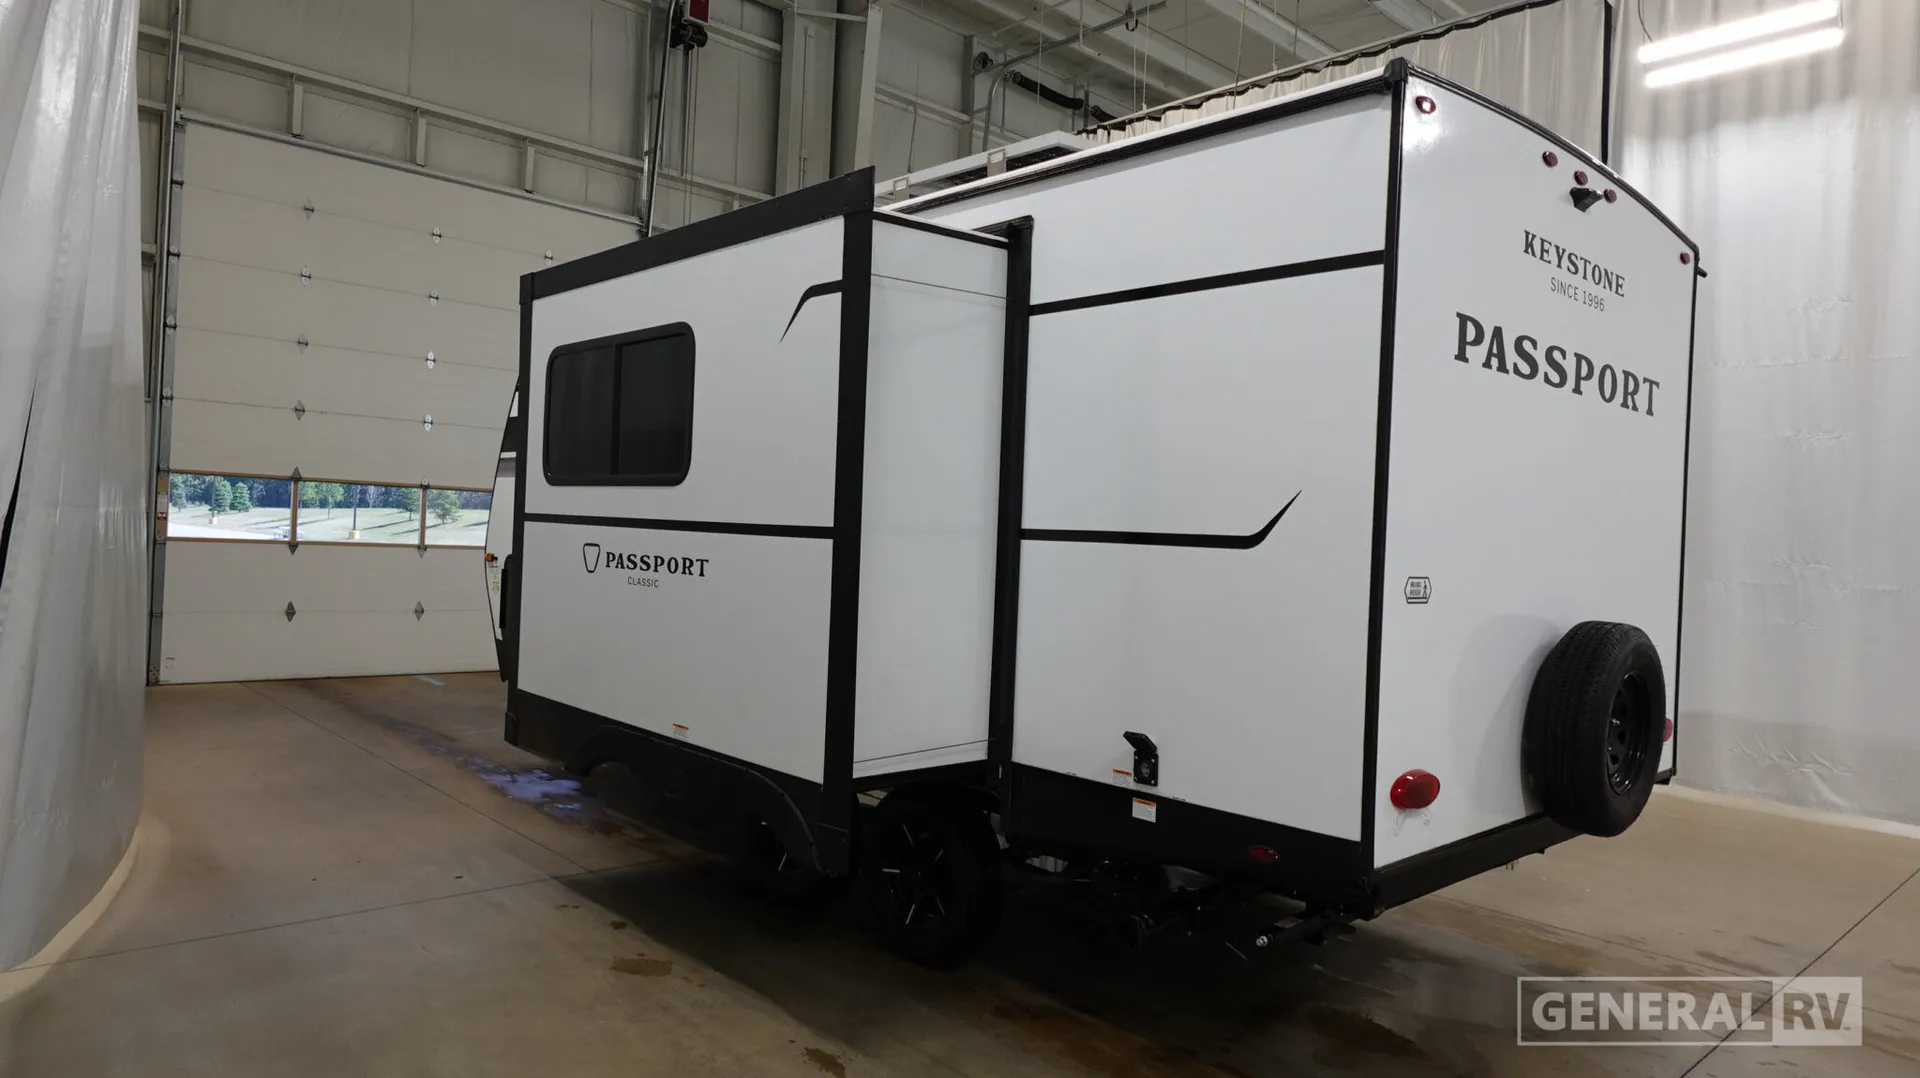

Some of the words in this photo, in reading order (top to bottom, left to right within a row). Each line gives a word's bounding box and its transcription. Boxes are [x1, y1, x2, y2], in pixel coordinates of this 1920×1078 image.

[1523, 229, 1625, 298] KEYSTONE
[1550, 277, 1579, 302] SINCE
[1582, 290, 1605, 312] 1996
[1454, 311, 1660, 417] PASSPORT
[605, 551, 709, 577] PASSPORT
[627, 576, 659, 588] CLASSIC
